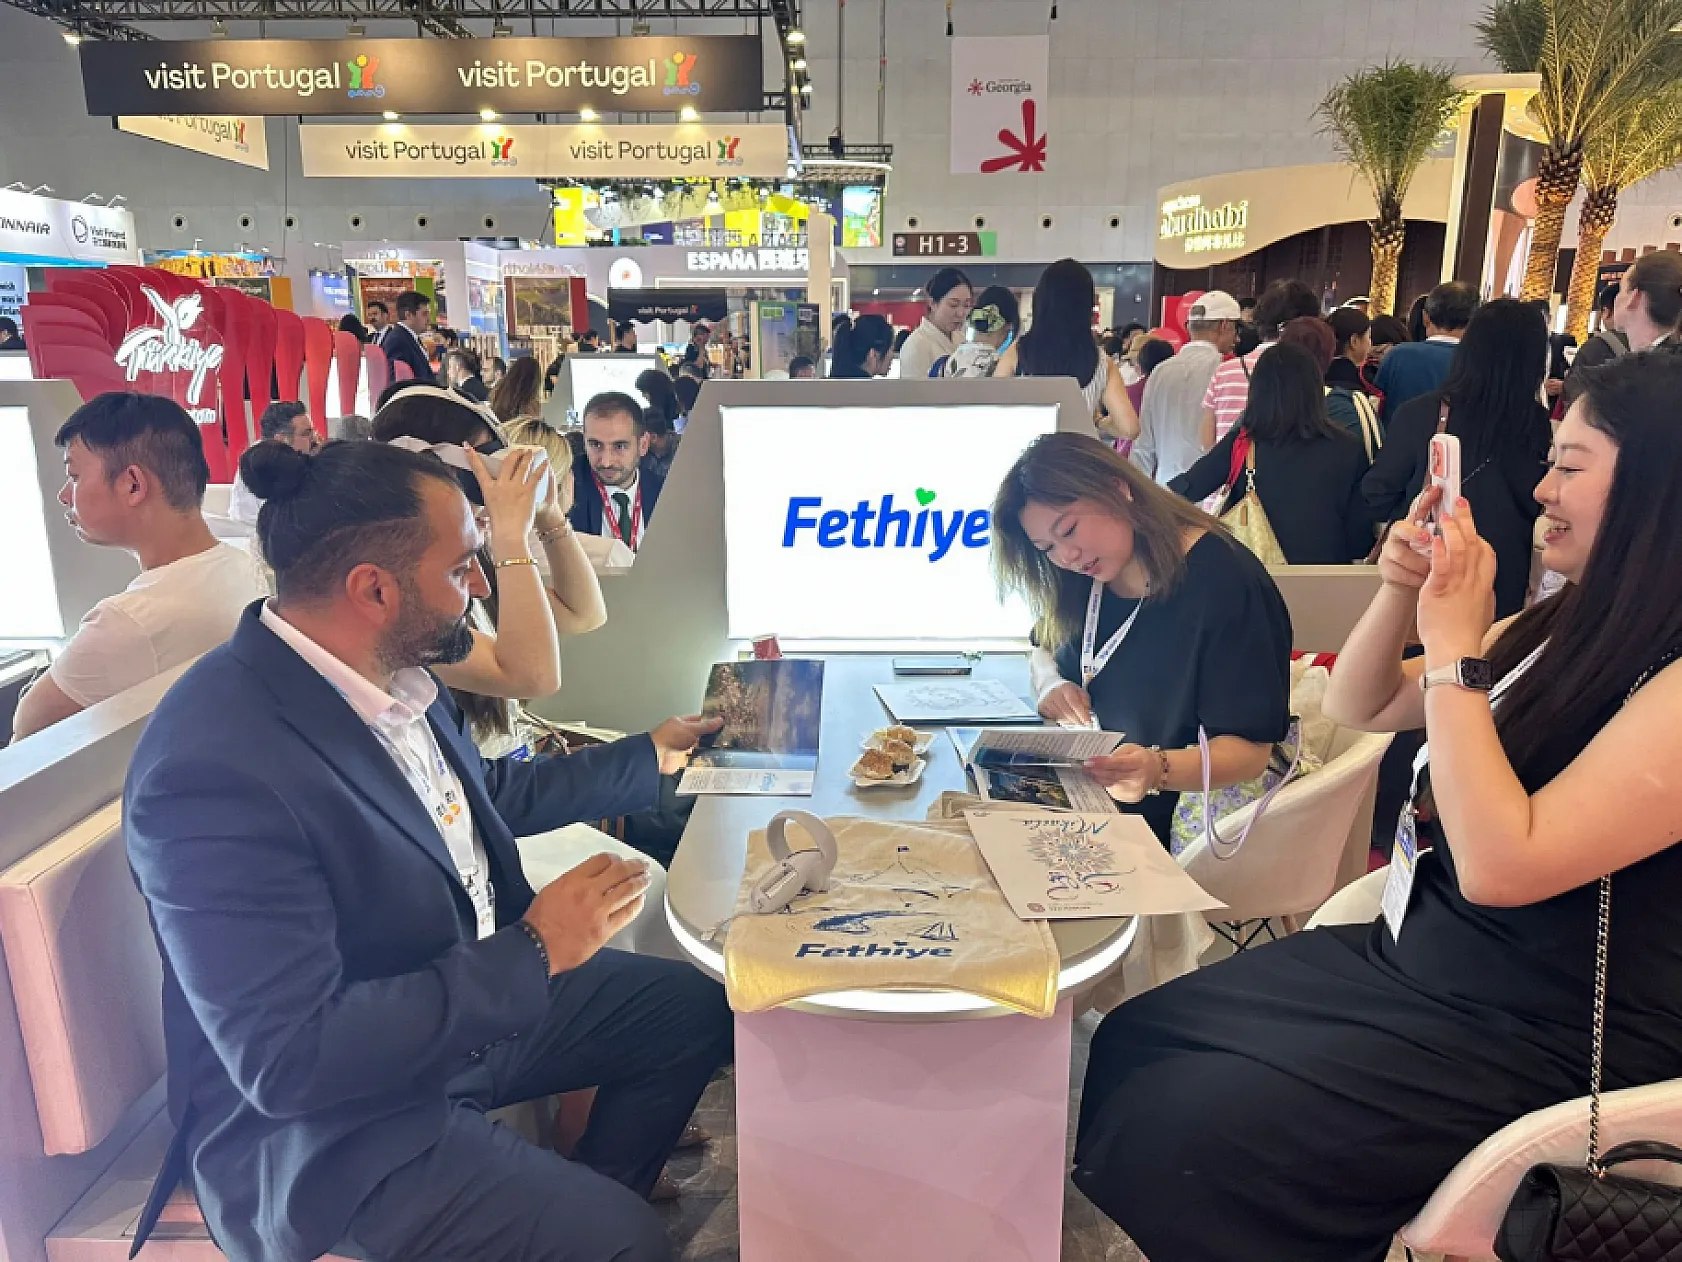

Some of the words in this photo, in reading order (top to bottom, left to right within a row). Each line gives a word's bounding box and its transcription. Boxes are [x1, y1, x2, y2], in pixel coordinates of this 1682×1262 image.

[144, 62, 206, 89] visit
[211, 62, 341, 96] Portugal
[457, 60, 521, 87] visit
[525, 59, 656, 95] Portugal
[985, 80, 1032, 95] Georgia
[345, 140, 389, 159] visit
[393, 141, 486, 164] Portugal
[569, 140, 614, 159] visit
[618, 141, 711, 164] Portugal
[0, 217, 51, 235] INNAIR
[919, 235, 969, 253] H1-3
[687, 248, 757, 271] ESPAÑA
[782, 488, 990, 563] Fethiye
[795, 940, 953, 958] Fethiye
